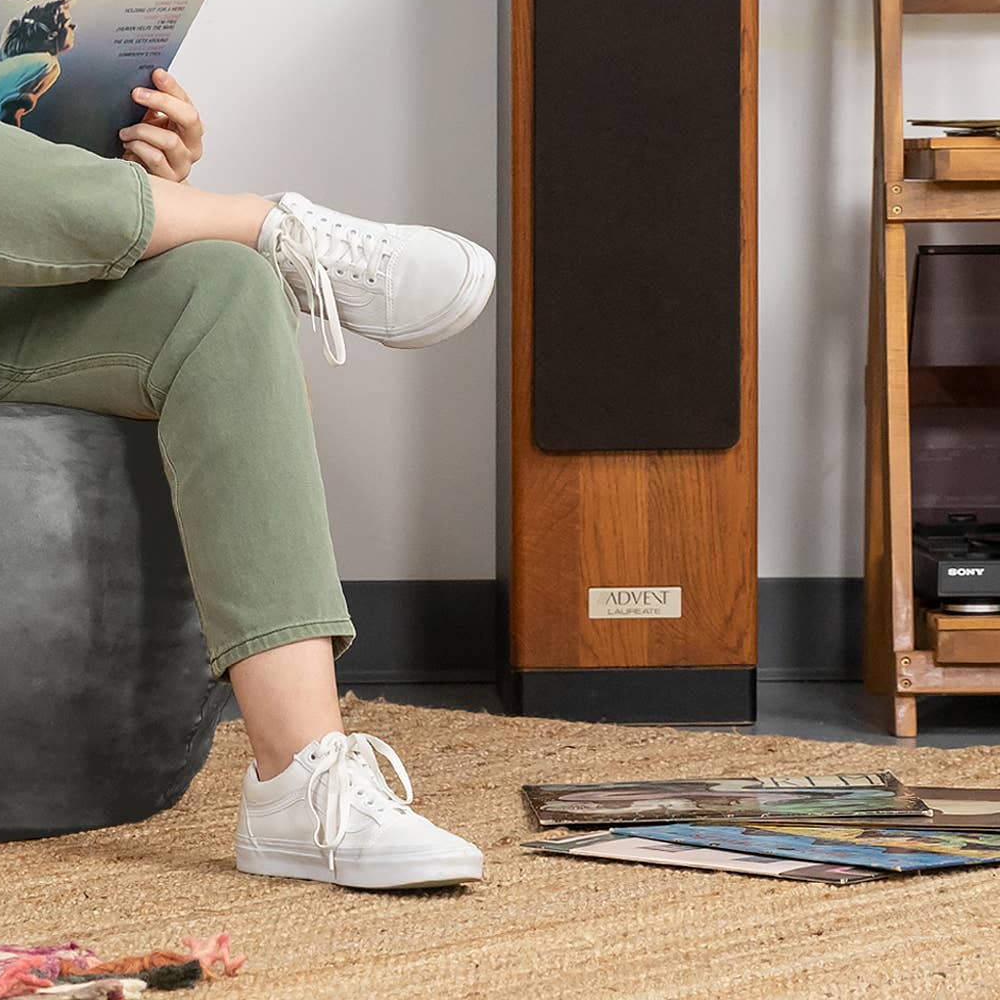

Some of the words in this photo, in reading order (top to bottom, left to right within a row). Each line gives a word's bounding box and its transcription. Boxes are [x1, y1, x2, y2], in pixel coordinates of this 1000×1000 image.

[947, 567, 985, 577] SONY
[605, 591, 671, 605] ADVENT
[607, 607, 660, 615] LAUREATE
